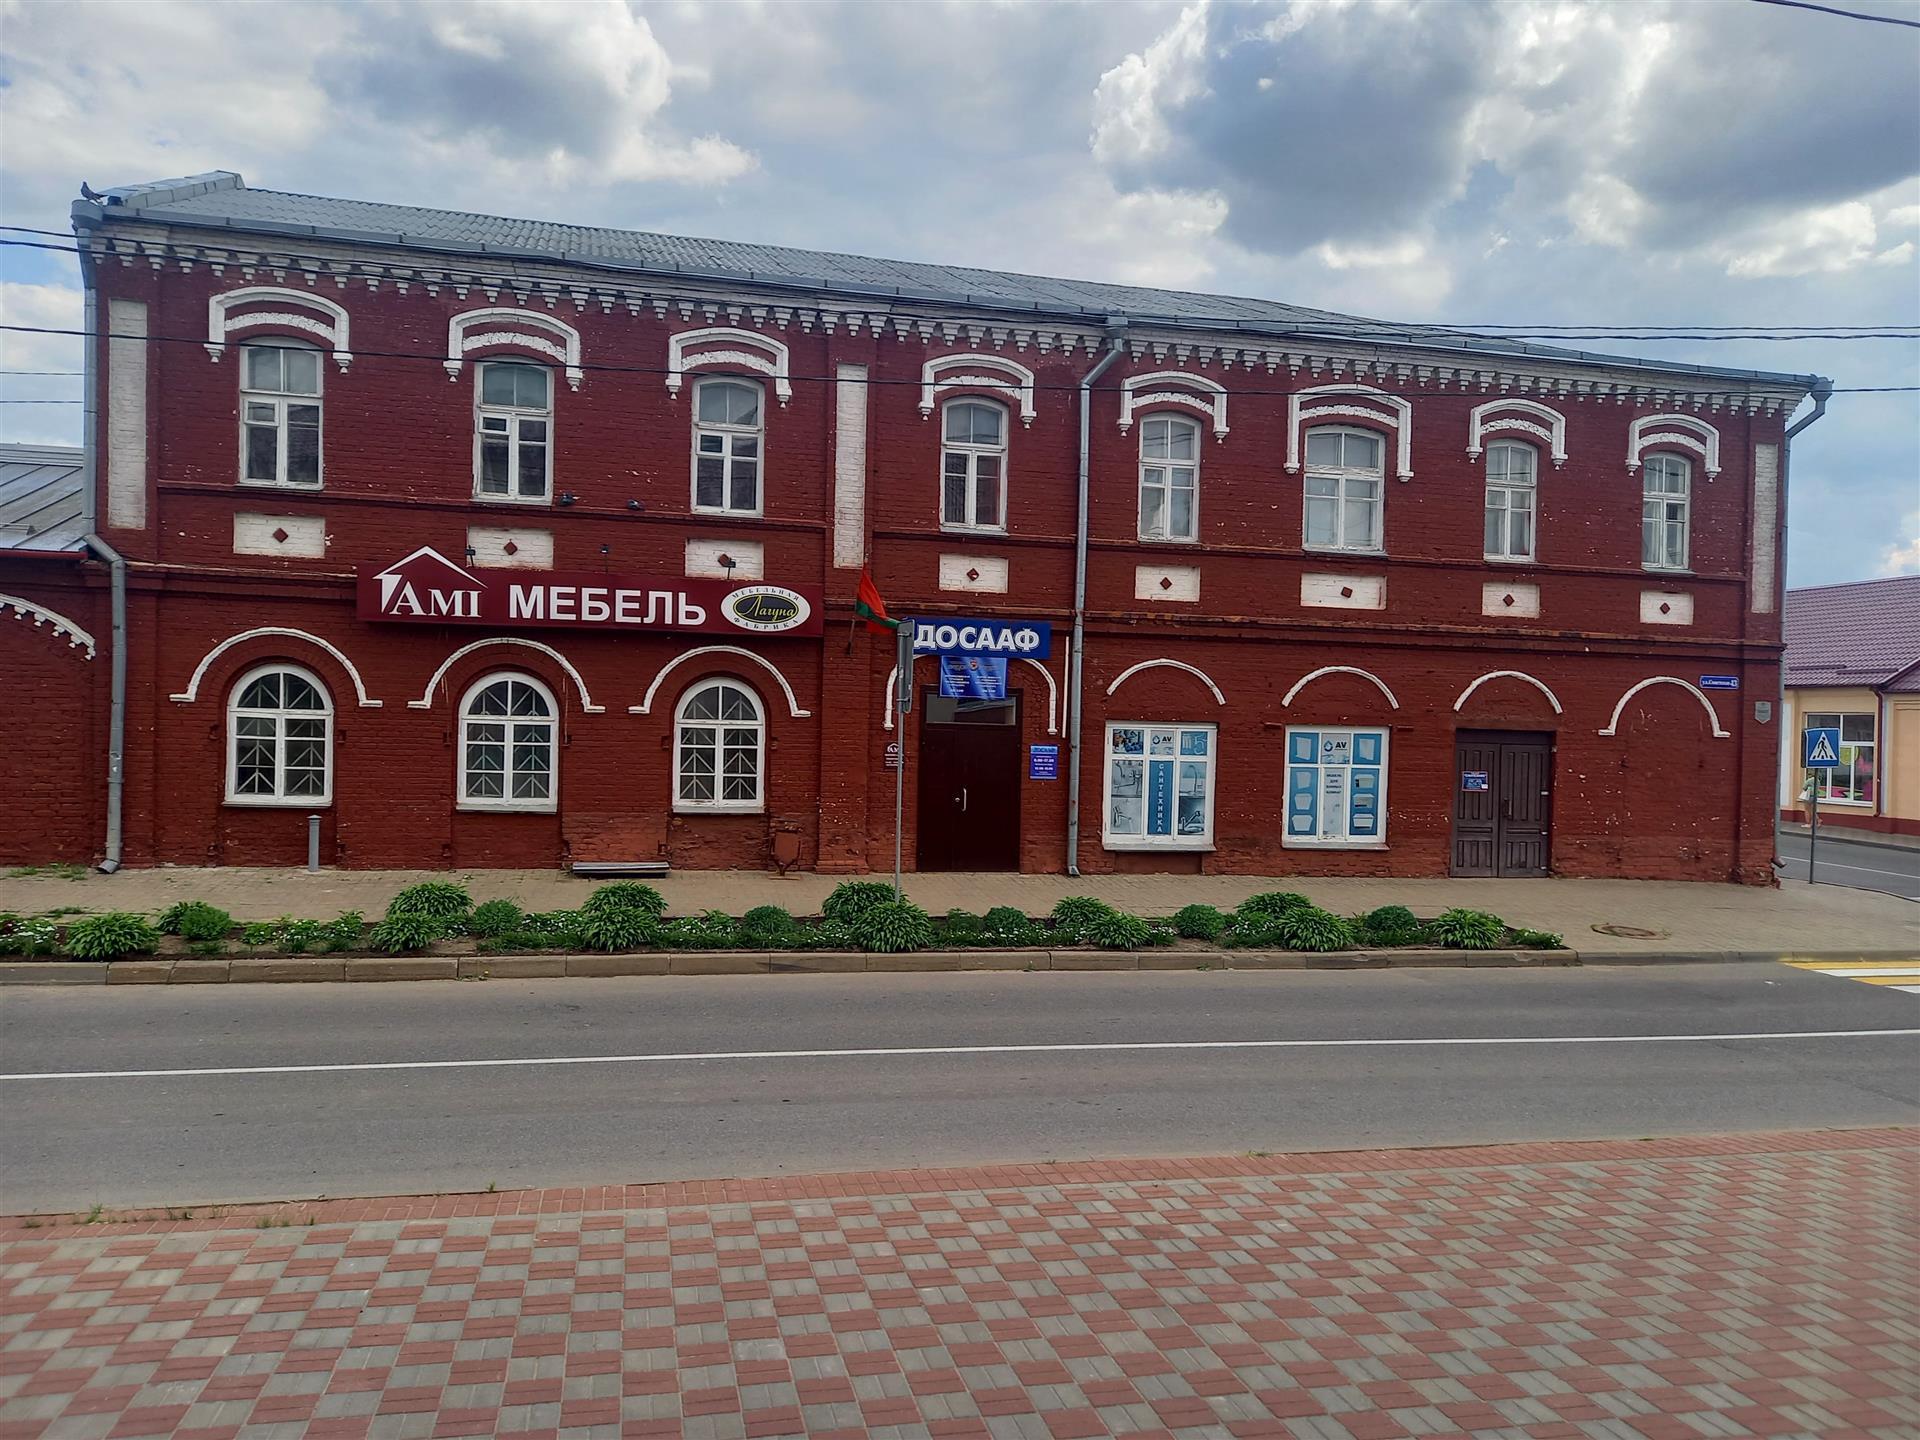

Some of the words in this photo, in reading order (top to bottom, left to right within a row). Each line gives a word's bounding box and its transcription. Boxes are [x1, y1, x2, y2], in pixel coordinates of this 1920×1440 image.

[509, 584, 706, 625] МЕБЕЛЬ
[732, 587, 800, 602] МЕБЕЛЬНАЯ
[739, 595, 795, 621] Лагуна
[733, 617, 799, 630] ФАБРИКА
[913, 624, 1040, 652] ДОСААФ
[1335, 741, 1347, 749] AV
[1157, 763, 1165, 832] САНТЕХНИКА
